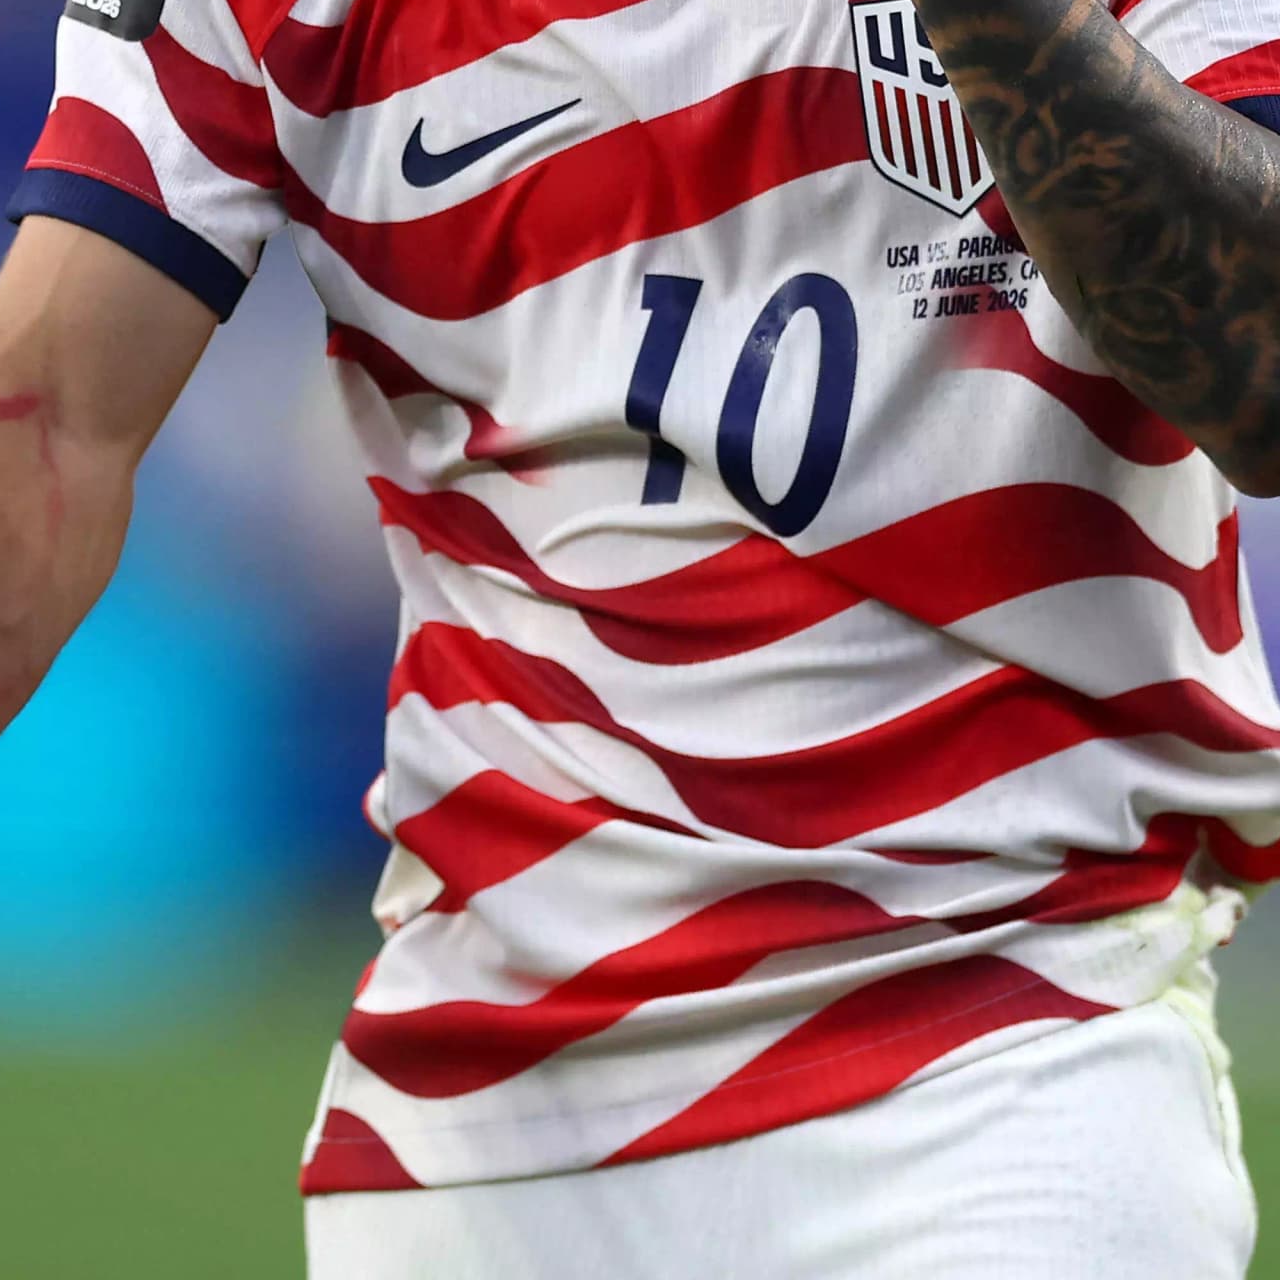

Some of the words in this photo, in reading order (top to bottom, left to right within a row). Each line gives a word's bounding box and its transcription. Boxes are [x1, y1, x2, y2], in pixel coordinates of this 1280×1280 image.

[887, 245, 920, 269] USA
[927, 241, 950, 264] VS.
[958, 235, 1025, 260] PARAG
[897, 272, 926, 295] LOS
[931, 262, 1013, 290] ANGELES,
[1021, 259, 1039, 281] CA
[912, 298, 928, 320] 12
[934, 293, 980, 318] JUNE
[987, 288, 1029, 313] 2026
[625, 272, 858, 538] 10
